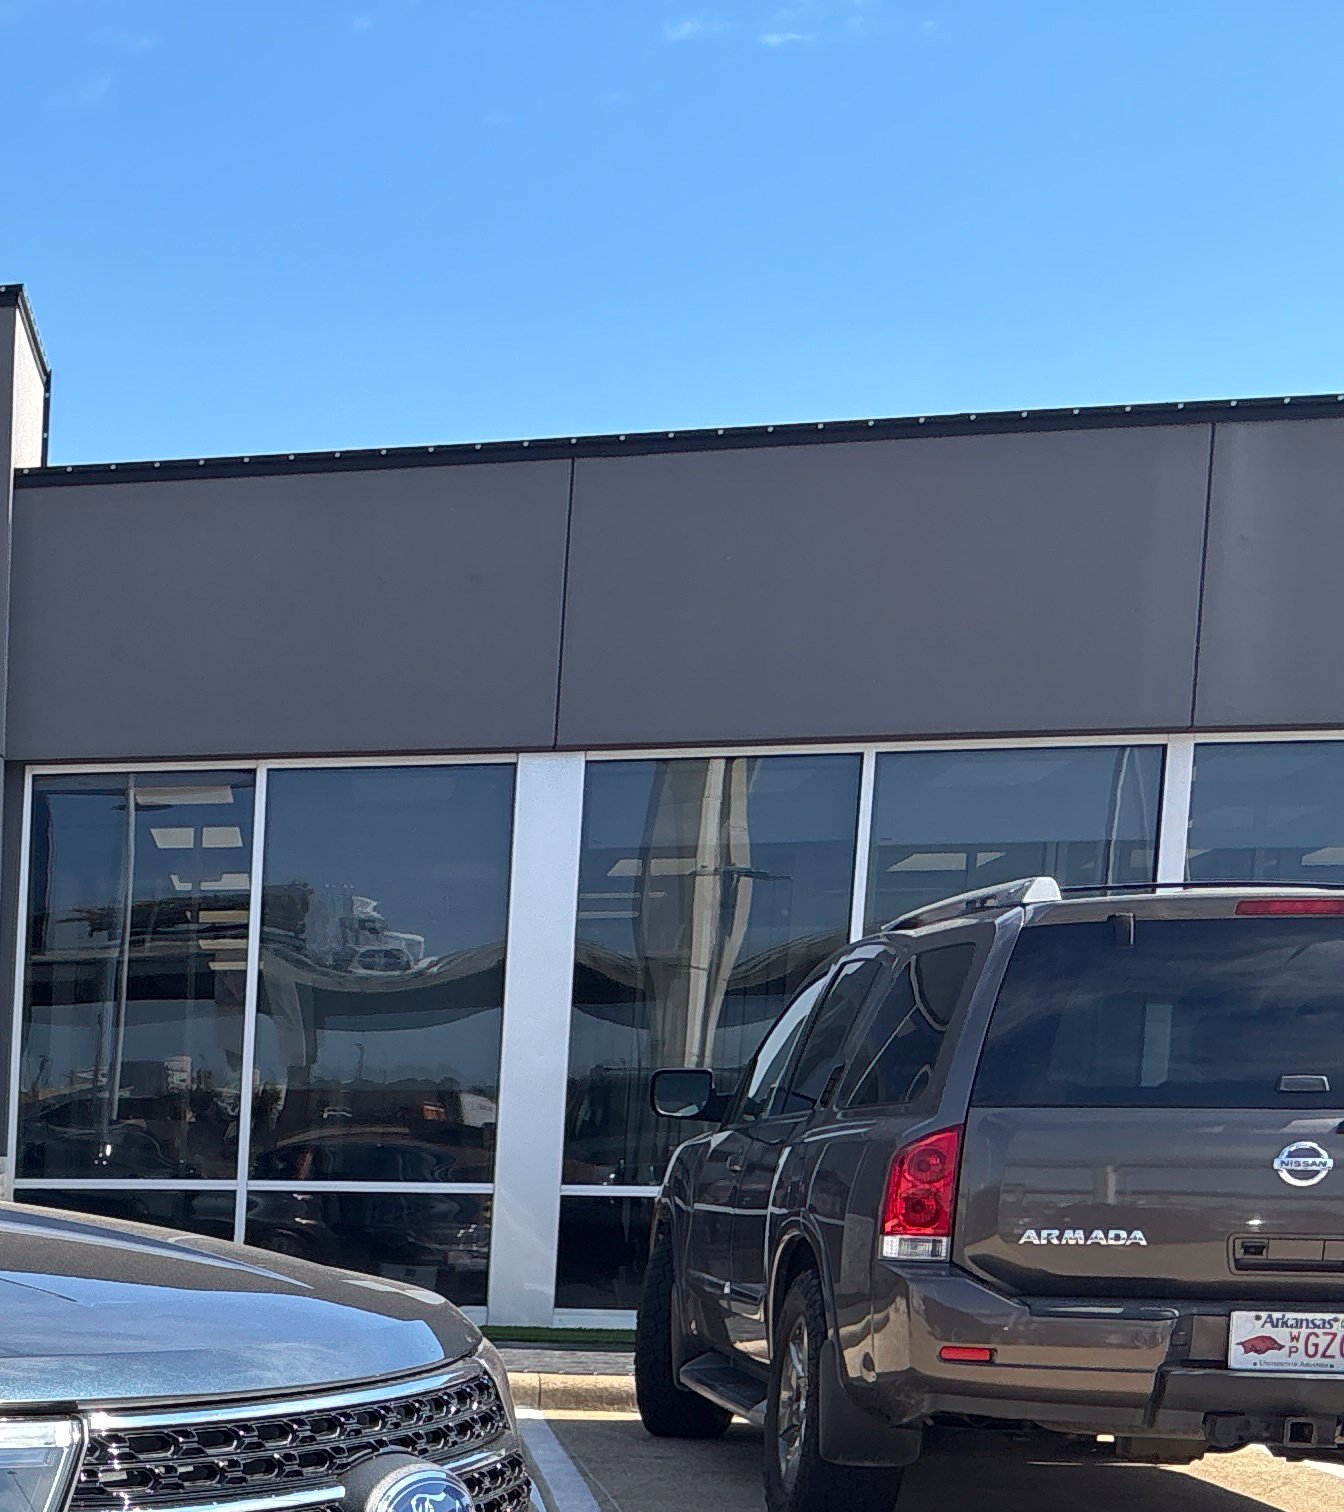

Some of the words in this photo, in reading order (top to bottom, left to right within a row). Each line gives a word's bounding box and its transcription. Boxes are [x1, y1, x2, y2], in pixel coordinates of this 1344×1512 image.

[1279, 1160, 1328, 1168] NISSAN
[1018, 1229, 1148, 1246] ARMADA
[1260, 1313, 1334, 1330] Arkansas
